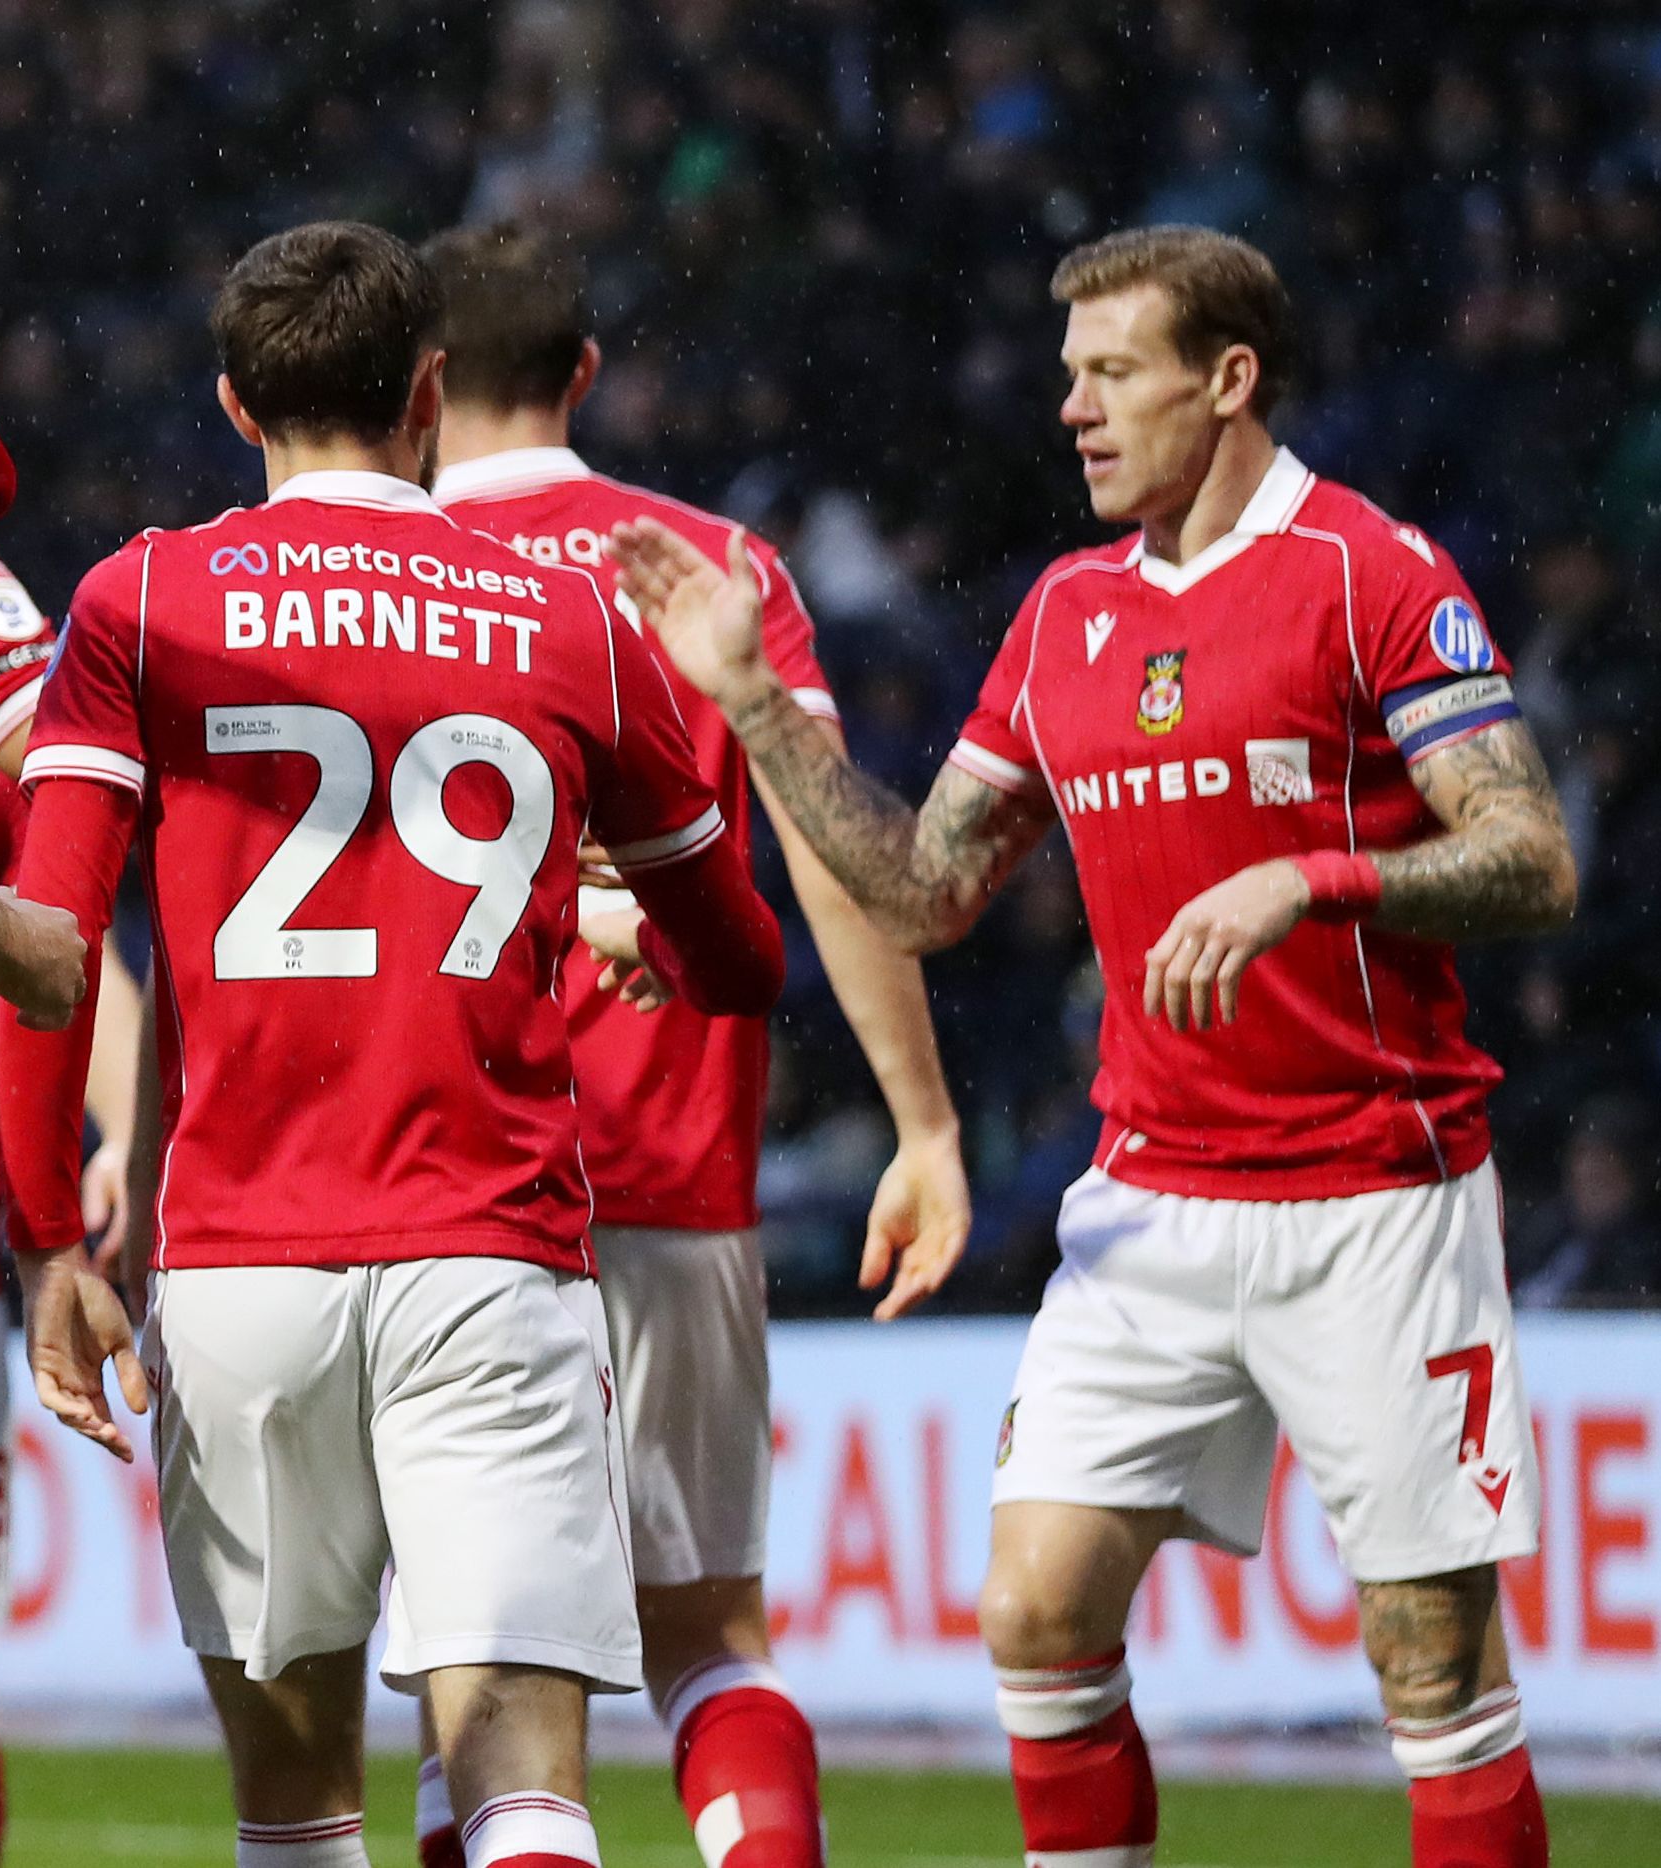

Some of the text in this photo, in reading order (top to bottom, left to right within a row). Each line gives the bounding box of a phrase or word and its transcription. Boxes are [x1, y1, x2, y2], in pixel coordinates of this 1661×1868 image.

[277, 542, 547, 604] Meta Quest
[224, 588, 542, 674] BARNETT
[1445, 600, 1485, 672] hp
[204, 703, 556, 981] 29
[285, 961, 303, 969] EFL
[465, 961, 480, 970] EFL
[1426, 1343, 1493, 1463] 7
